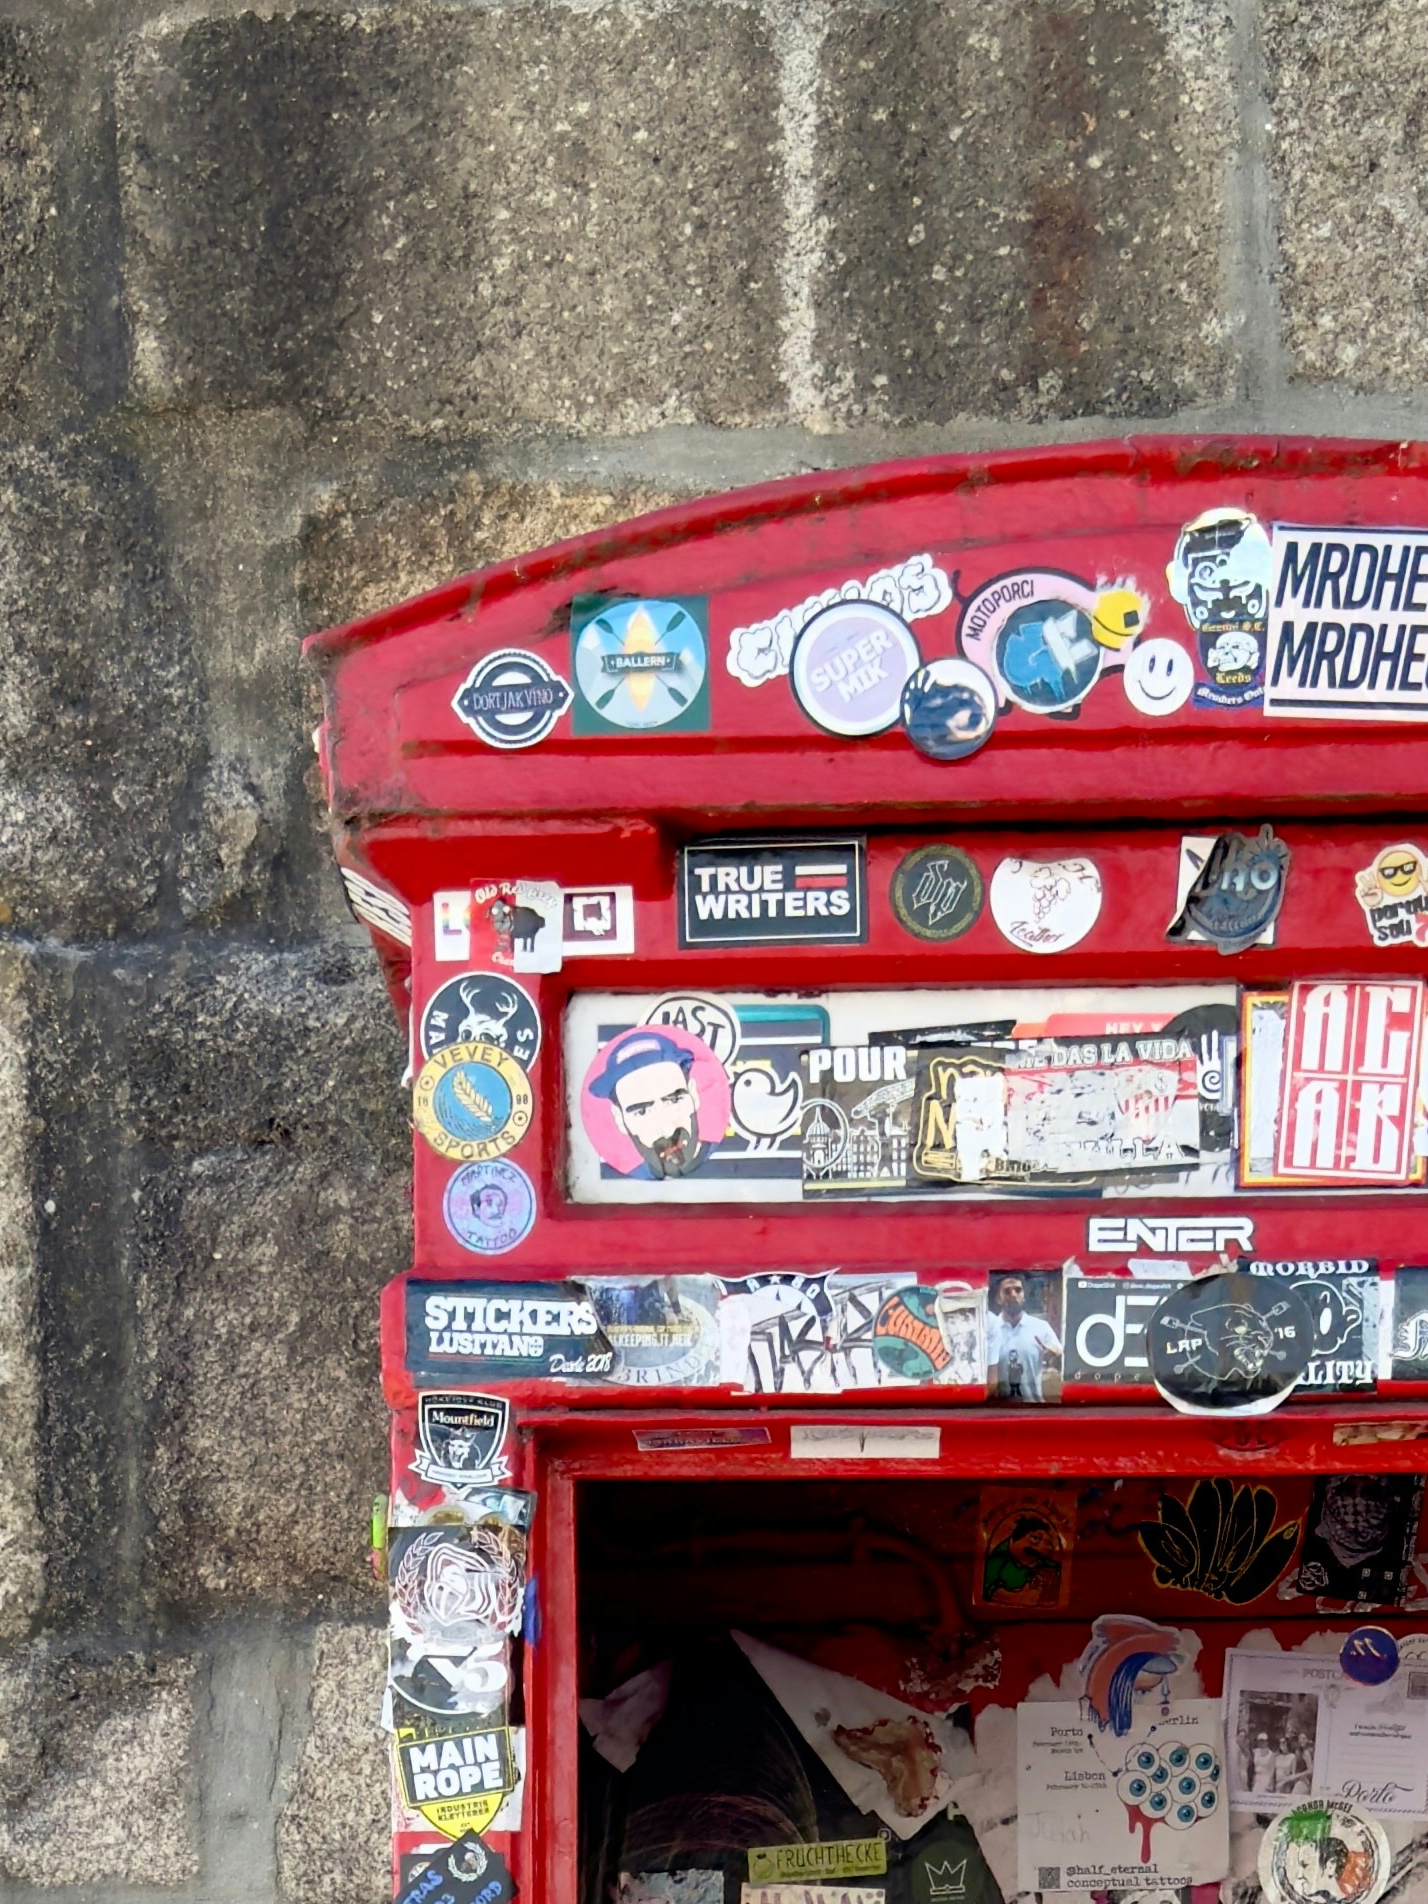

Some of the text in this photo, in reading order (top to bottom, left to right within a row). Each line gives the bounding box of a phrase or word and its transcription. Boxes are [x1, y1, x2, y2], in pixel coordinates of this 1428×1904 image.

[965, 578, 1036, 642] MOTOPORCI
[615, 655, 666, 672] BALLERN
[809, 627, 893, 695] SUPER
[695, 864, 785, 891] TRUE
[695, 888, 852, 921] WRITERS
[432, 1042, 510, 1072] VEVEY
[809, 1046, 909, 1084] POUR
[1052, 1037, 1197, 1067] DAS LA VIDA
[432, 1126, 517, 1161] SPORTS
[1088, 1215, 1256, 1253] ENTER
[1249, 1259, 1370, 1279] MORBID
[423, 1297, 599, 1336] STICKERS
[584, 1350, 613, 1373] 2018
[431, 1410, 495, 1429] Mountfield
[1050, 1726, 1084, 1738] Porto
[409, 1732, 500, 1774] MAIN
[413, 1764, 504, 1801] ROPE
[1063, 1770, 1107, 1783] Lisbon
[775, 1840, 883, 1870] FRUCHTHECKE
[1066, 1862, 1159, 1878] @half_eternal
[1066, 1874, 1194, 1891] conceptual tattoos
